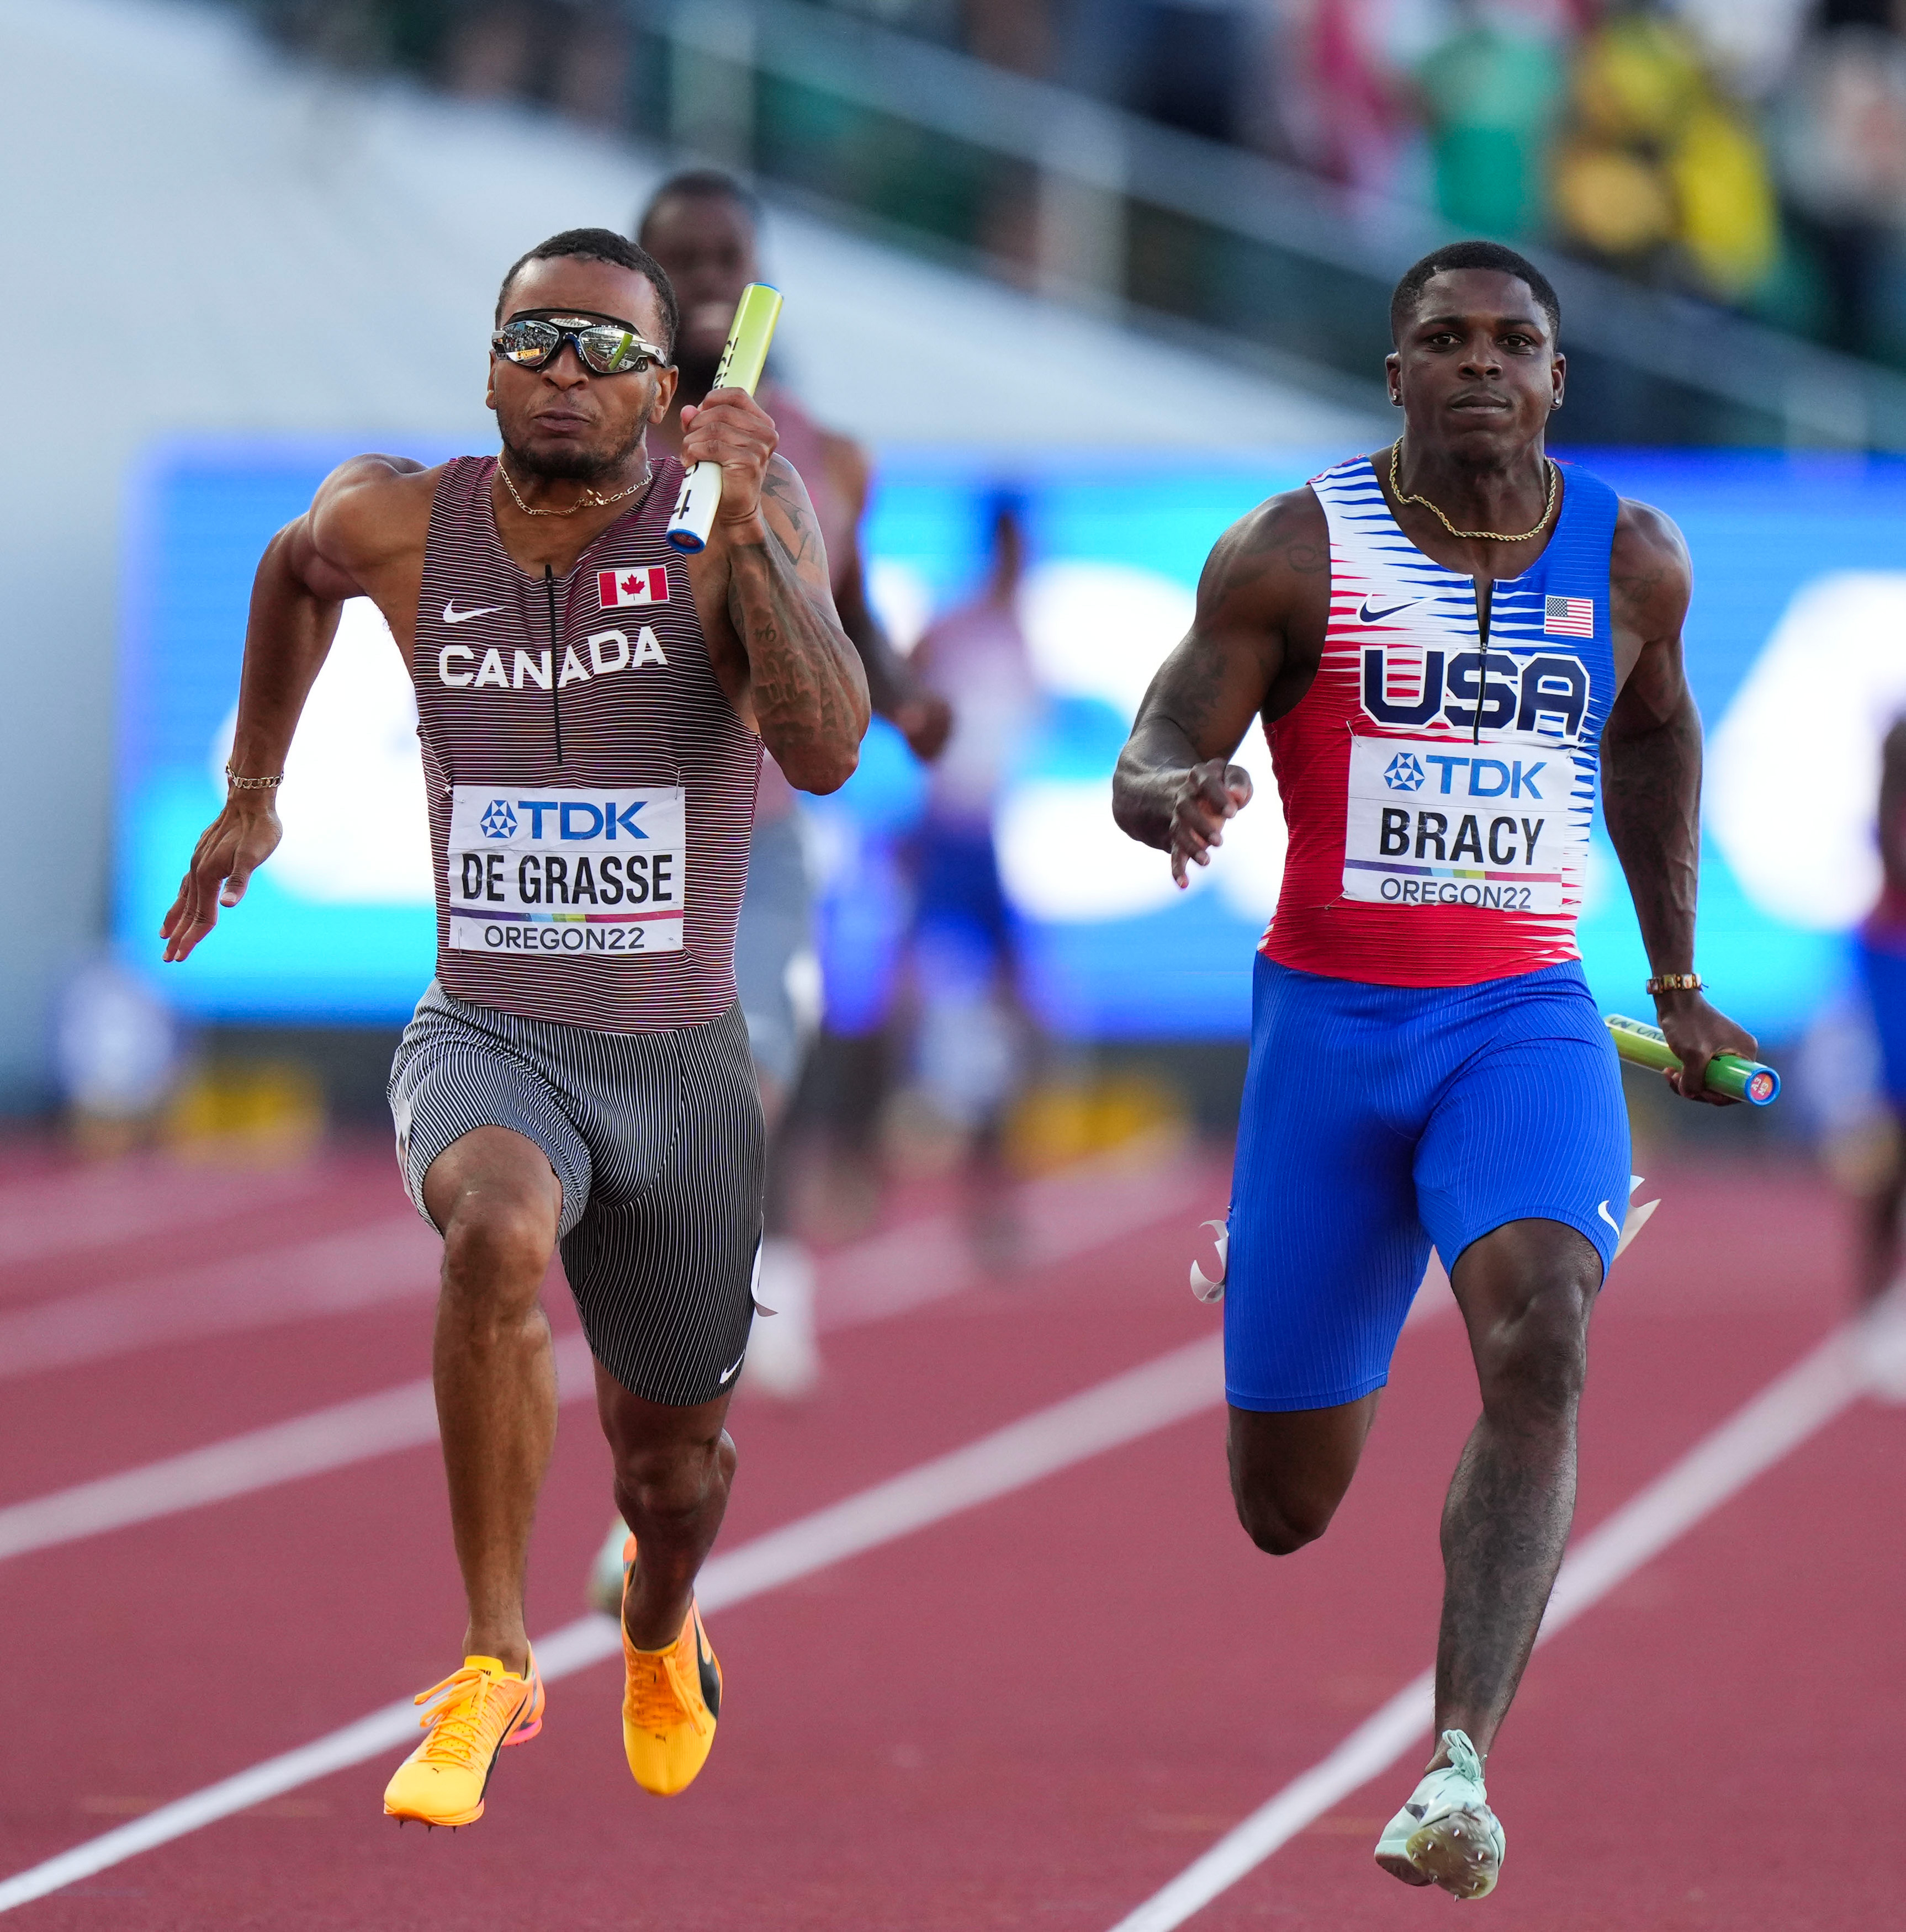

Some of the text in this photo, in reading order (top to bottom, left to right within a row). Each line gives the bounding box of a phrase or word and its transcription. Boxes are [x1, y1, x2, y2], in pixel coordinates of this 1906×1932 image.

[439, 625, 669, 690] CANADA
[1360, 645, 1590, 741] USA
[1426, 754, 1548, 799] TDK
[518, 801, 650, 840] TDK
[1380, 808, 1545, 866] BRACY
[462, 853, 673, 905] DE GRASSE
[1380, 877, 1532, 910] OREGON22
[484, 925, 645, 951] OREGON22
[1751, 1078, 1761, 1092] A3
[1758, 1082, 1770, 1097] M3
